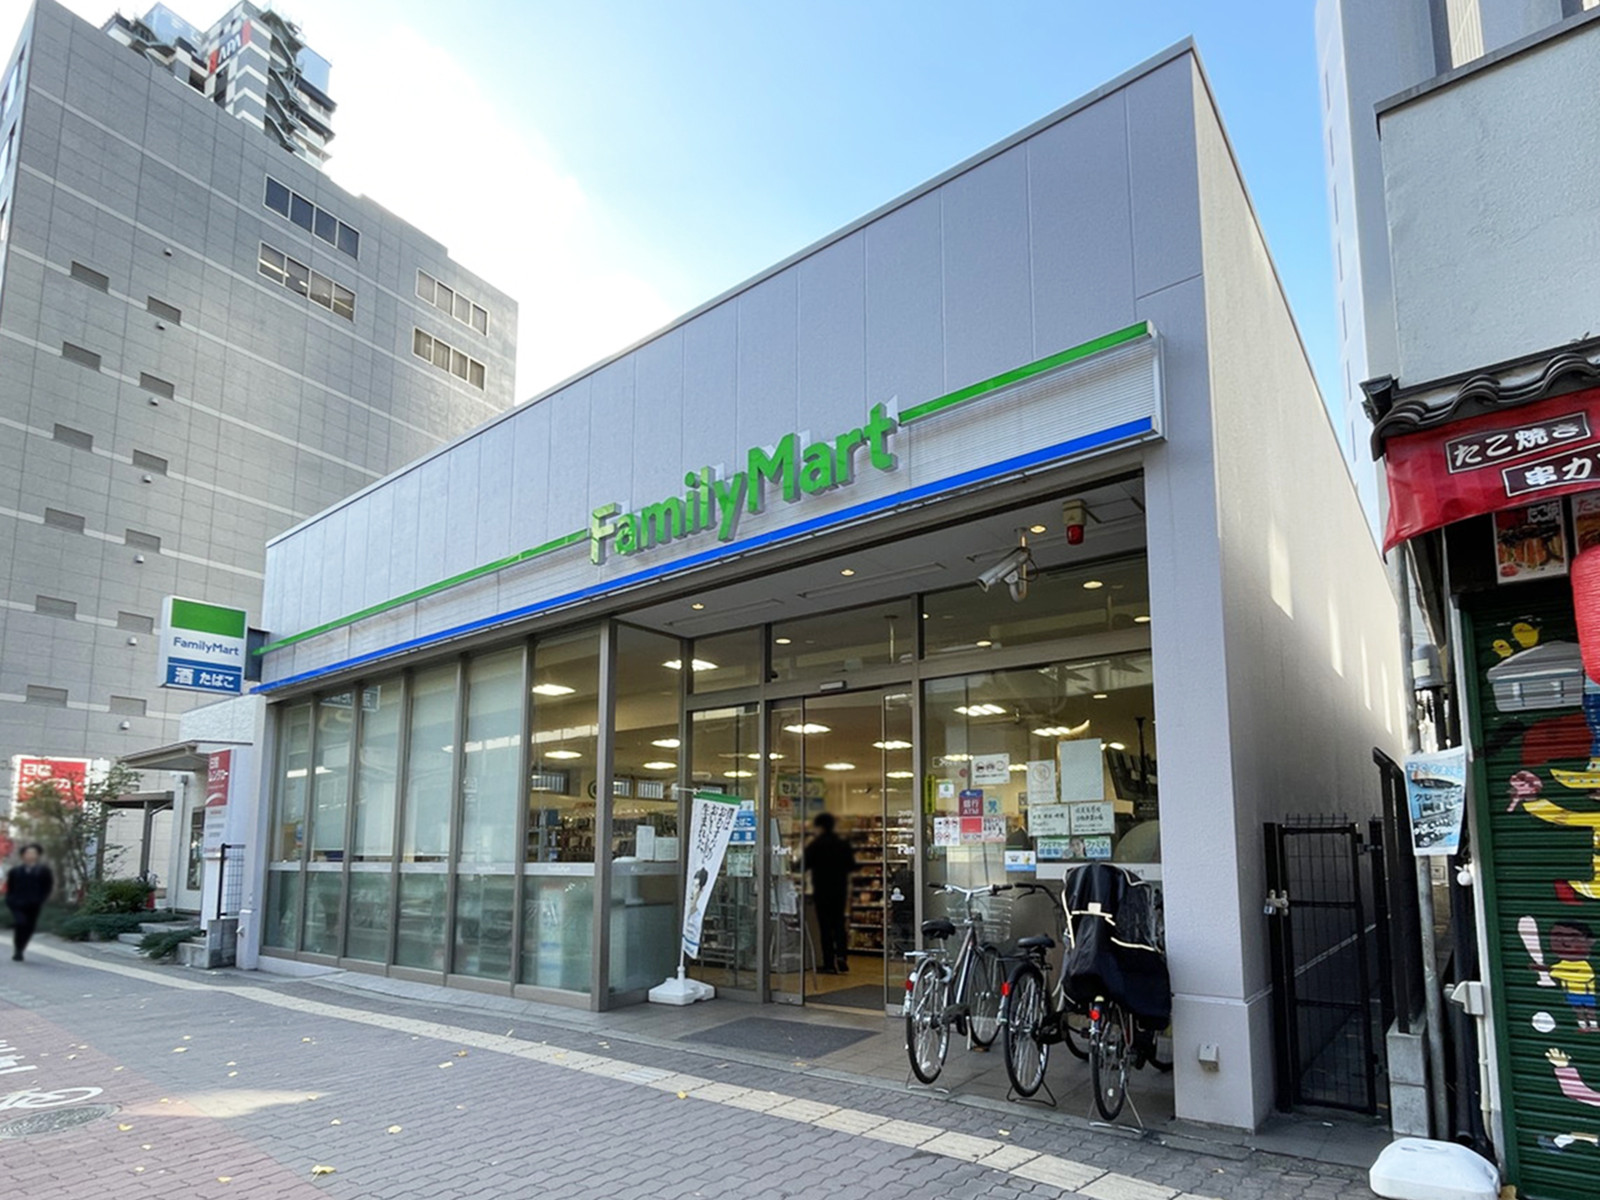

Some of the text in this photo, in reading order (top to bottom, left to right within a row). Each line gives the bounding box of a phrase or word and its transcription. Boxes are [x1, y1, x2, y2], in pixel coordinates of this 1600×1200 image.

[1453, 422, 1579, 467] たこ焼き
[590, 401, 896, 567] FamilyMart
[1524, 452, 1600, 486] 串カ
[173, 636, 240, 656] FamilyMart
[174, 666, 235, 689] 酒 たばこ
